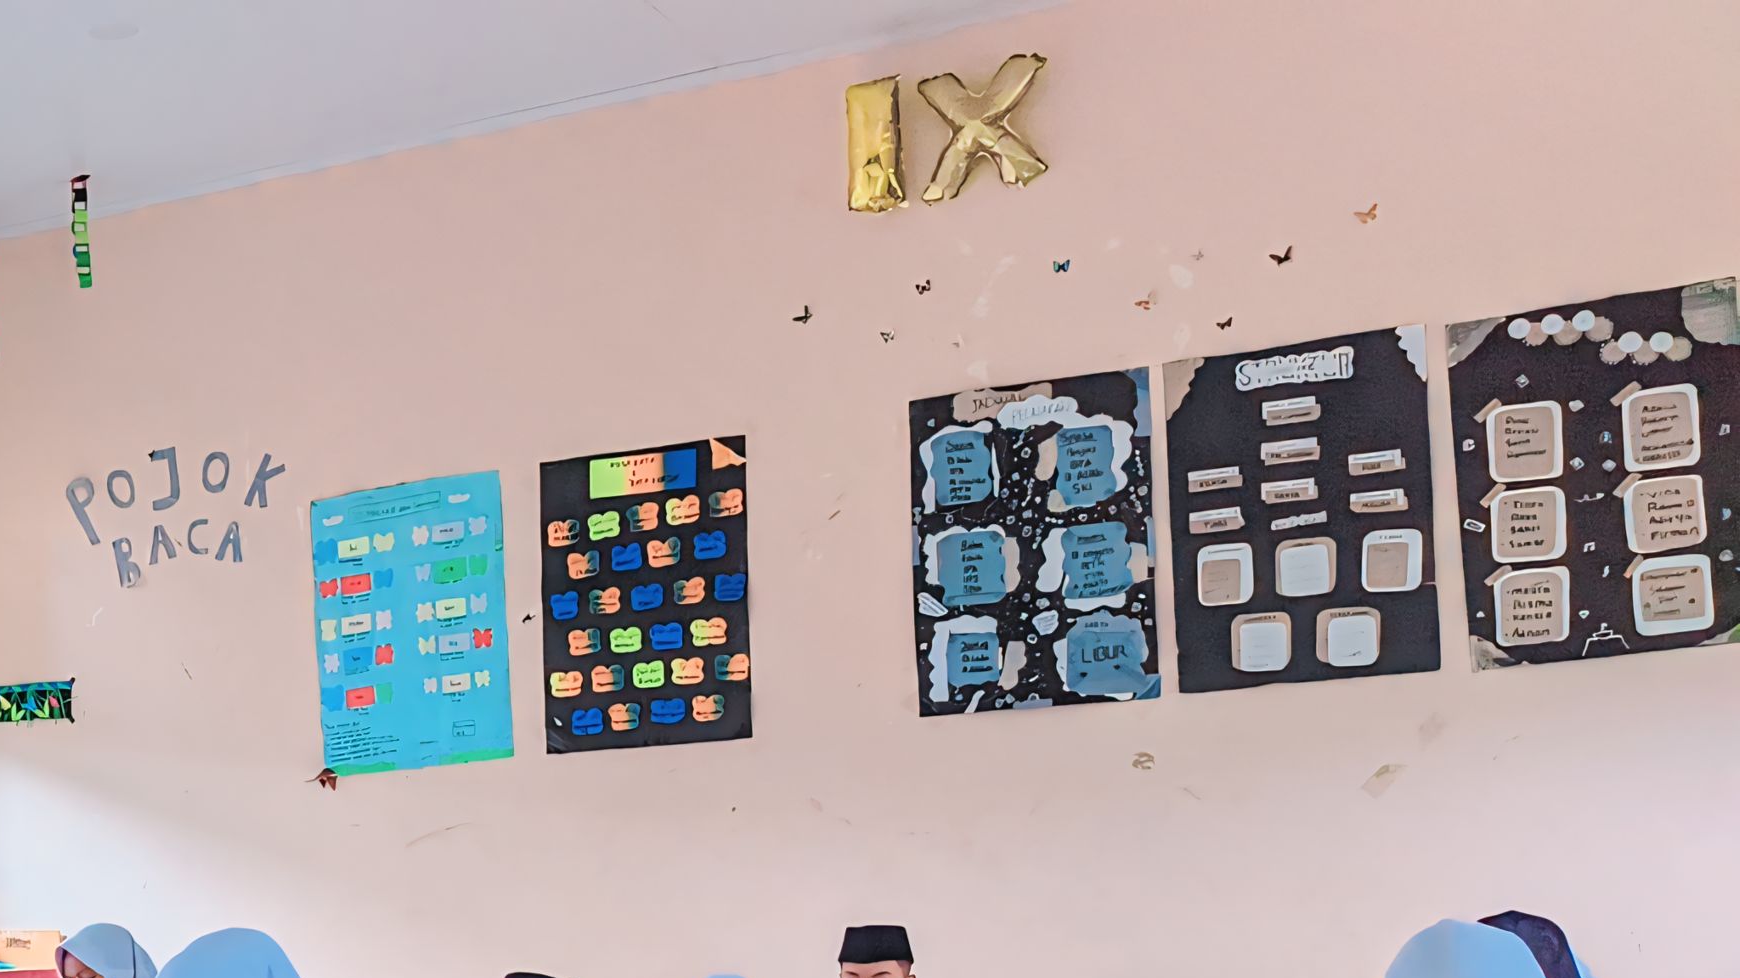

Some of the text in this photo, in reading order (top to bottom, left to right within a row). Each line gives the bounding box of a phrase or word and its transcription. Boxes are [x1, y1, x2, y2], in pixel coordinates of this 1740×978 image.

[846, 52, 1049, 213] IX
[66, 446, 286, 546] POJOK
[112, 518, 243, 589] BACA
